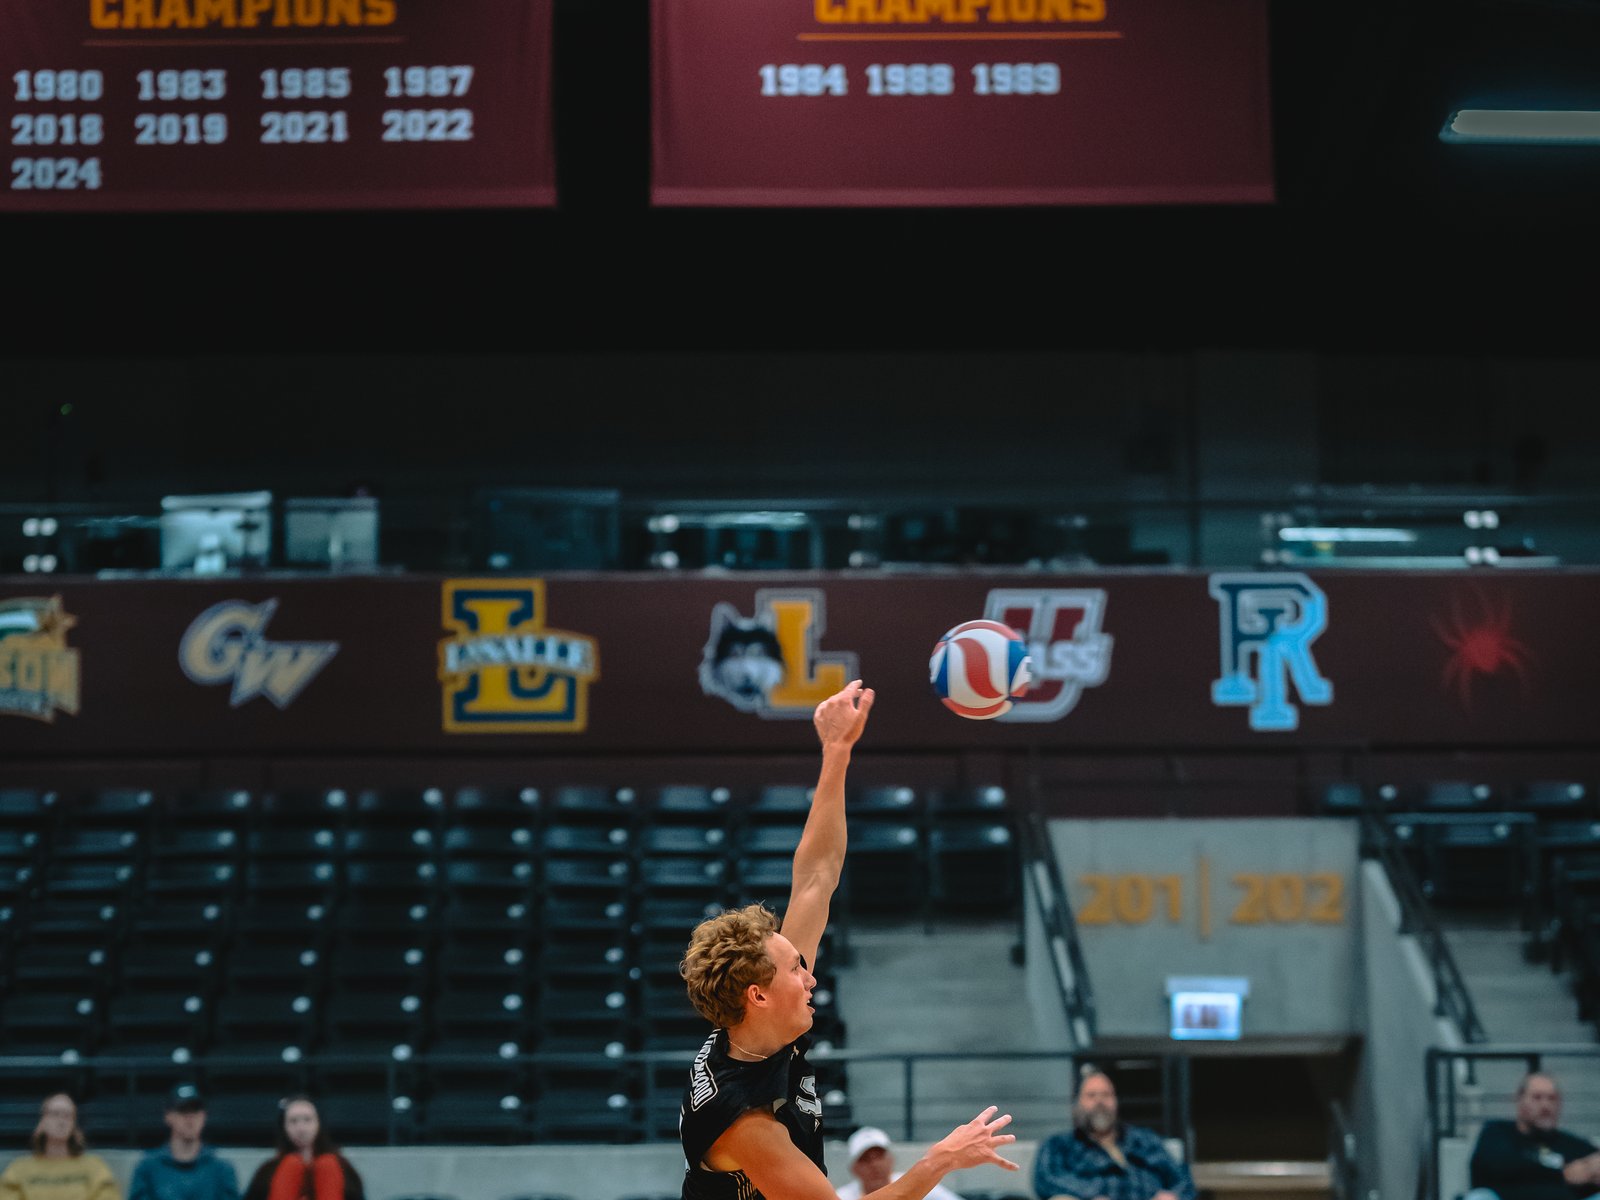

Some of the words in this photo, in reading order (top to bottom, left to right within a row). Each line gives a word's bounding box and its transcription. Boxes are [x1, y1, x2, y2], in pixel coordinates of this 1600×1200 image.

[89, 0, 397, 28] CHAMPIONS
[12, 69, 102, 100] 1980
[136, 69, 227, 100] 1983
[260, 67, 351, 99] 1985
[383, 65, 474, 98] 1987
[758, 63, 848, 96] 1984
[11, 113, 102, 145] 2018
[135, 113, 227, 144] 2019
[260, 111, 349, 144] 2021
[382, 109, 474, 141] 2022
[11, 157, 101, 190] 2024
[1076, 873, 1181, 925] 201
[1230, 873, 1344, 925] 202
